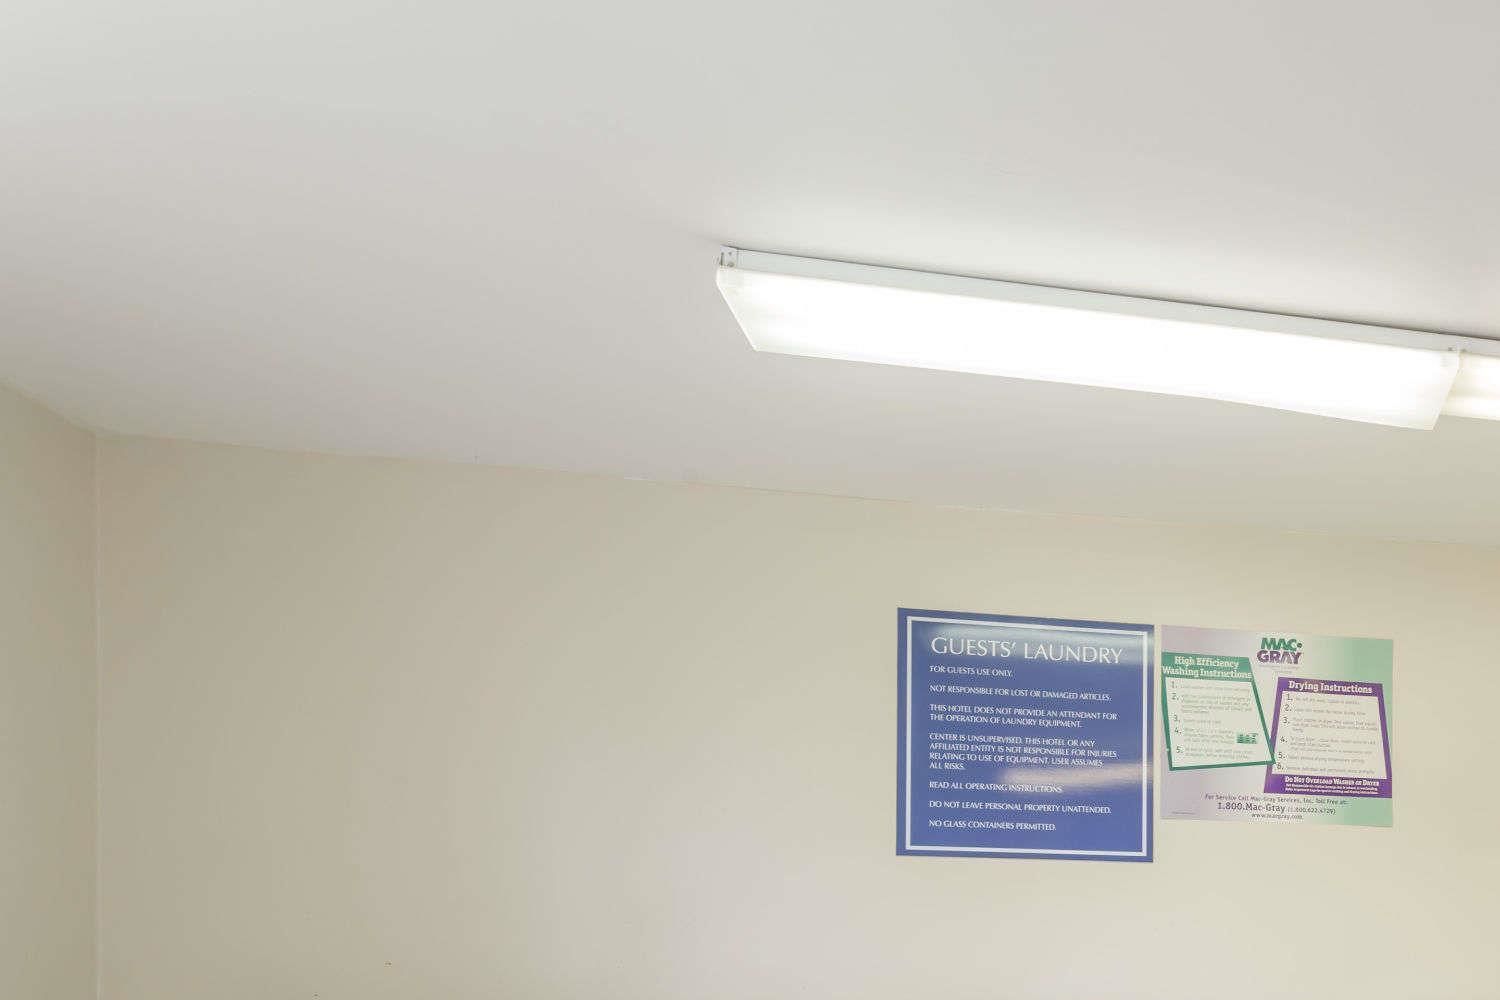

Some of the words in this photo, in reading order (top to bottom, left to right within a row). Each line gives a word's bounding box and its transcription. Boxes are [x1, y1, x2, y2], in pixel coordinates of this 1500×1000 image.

[1023, 642, 1123, 664] LAUNDRY
[1256, 649, 1302, 664] GRAY
[1174, 655, 1195, 667] High
[1196, 657, 1240, 668] Efficiency
[929, 665, 946, 673] FOR
[947, 666, 975, 675] GUESTS
[976, 668, 991, 676] USE
[1161, 665, 1198, 677] Washing
[1199, 668, 1253, 679] Instructions
[929, 684, 946, 692] NOT
[947, 685, 993, 695] RESPONSIBLE
[994, 688, 1009, 696] FOR
[1010, 688, 1029, 697] LOST
[1030, 690, 1041, 698] OR
[1042, 690, 1078, 700] DAMAGED
[1288, 680, 1319, 692] Drying
[1320, 682, 1373, 694] Instructions
[929, 703, 947, 712] THIS
[948, 705, 972, 713] HOTEL
[974, 706, 995, 715] DOES
[996, 707, 1012, 716] NOT
[1013, 708, 1046, 718] PROVIDE
[1047, 710, 1058, 718] AN
[1059, 711, 1101, 720] ATTENDANT
[1102, 712, 1119, 720] FOR
[929, 713, 944, 721] THE
[945, 714, 988, 724] OPERATION
[989, 716, 1001, 724] OF
[1002, 717, 1036, 726] LAUNDRY
[929, 733, 959, 741] CENTER
[1024, 737, 1041, 745] THIS
[1042, 738, 1066, 747] HOTEL
[1067, 739, 1079, 748] OR
[1079, 740, 1096, 748] ANY
[929, 743, 970, 752] AFFILIATED
[970, 744, 996, 753] ENTITY
[1005, 746, 1022, 754] NOT
[1023, 747, 1070, 757] RESPONSIBLE
[1071, 749, 1086, 757] FOR
[929, 753, 965, 761] RELATING
[966, 754, 978, 762] TO
[978, 754, 993, 763] USE
[993, 755, 1005, 763] OF
[1051, 758, 1070, 766] USER
[1071, 759, 1104, 768] ASSUMES
[929, 781, 950, 789] READ
[950, 782, 965, 790] ALL
[965, 783, 1008, 792] OPERATING
[928, 800, 942, 808] DO
[943, 801, 960, 809] NOT
[961, 802, 984, 810] LEAVE
[985, 802, 1022, 812] PERSONAL
[1023, 803, 1060, 813] PROPERTY
[928, 819, 942, 827] NO
[943, 820, 967, 829] GLASS
[967, 821, 1015, 830] CONTAINERS
